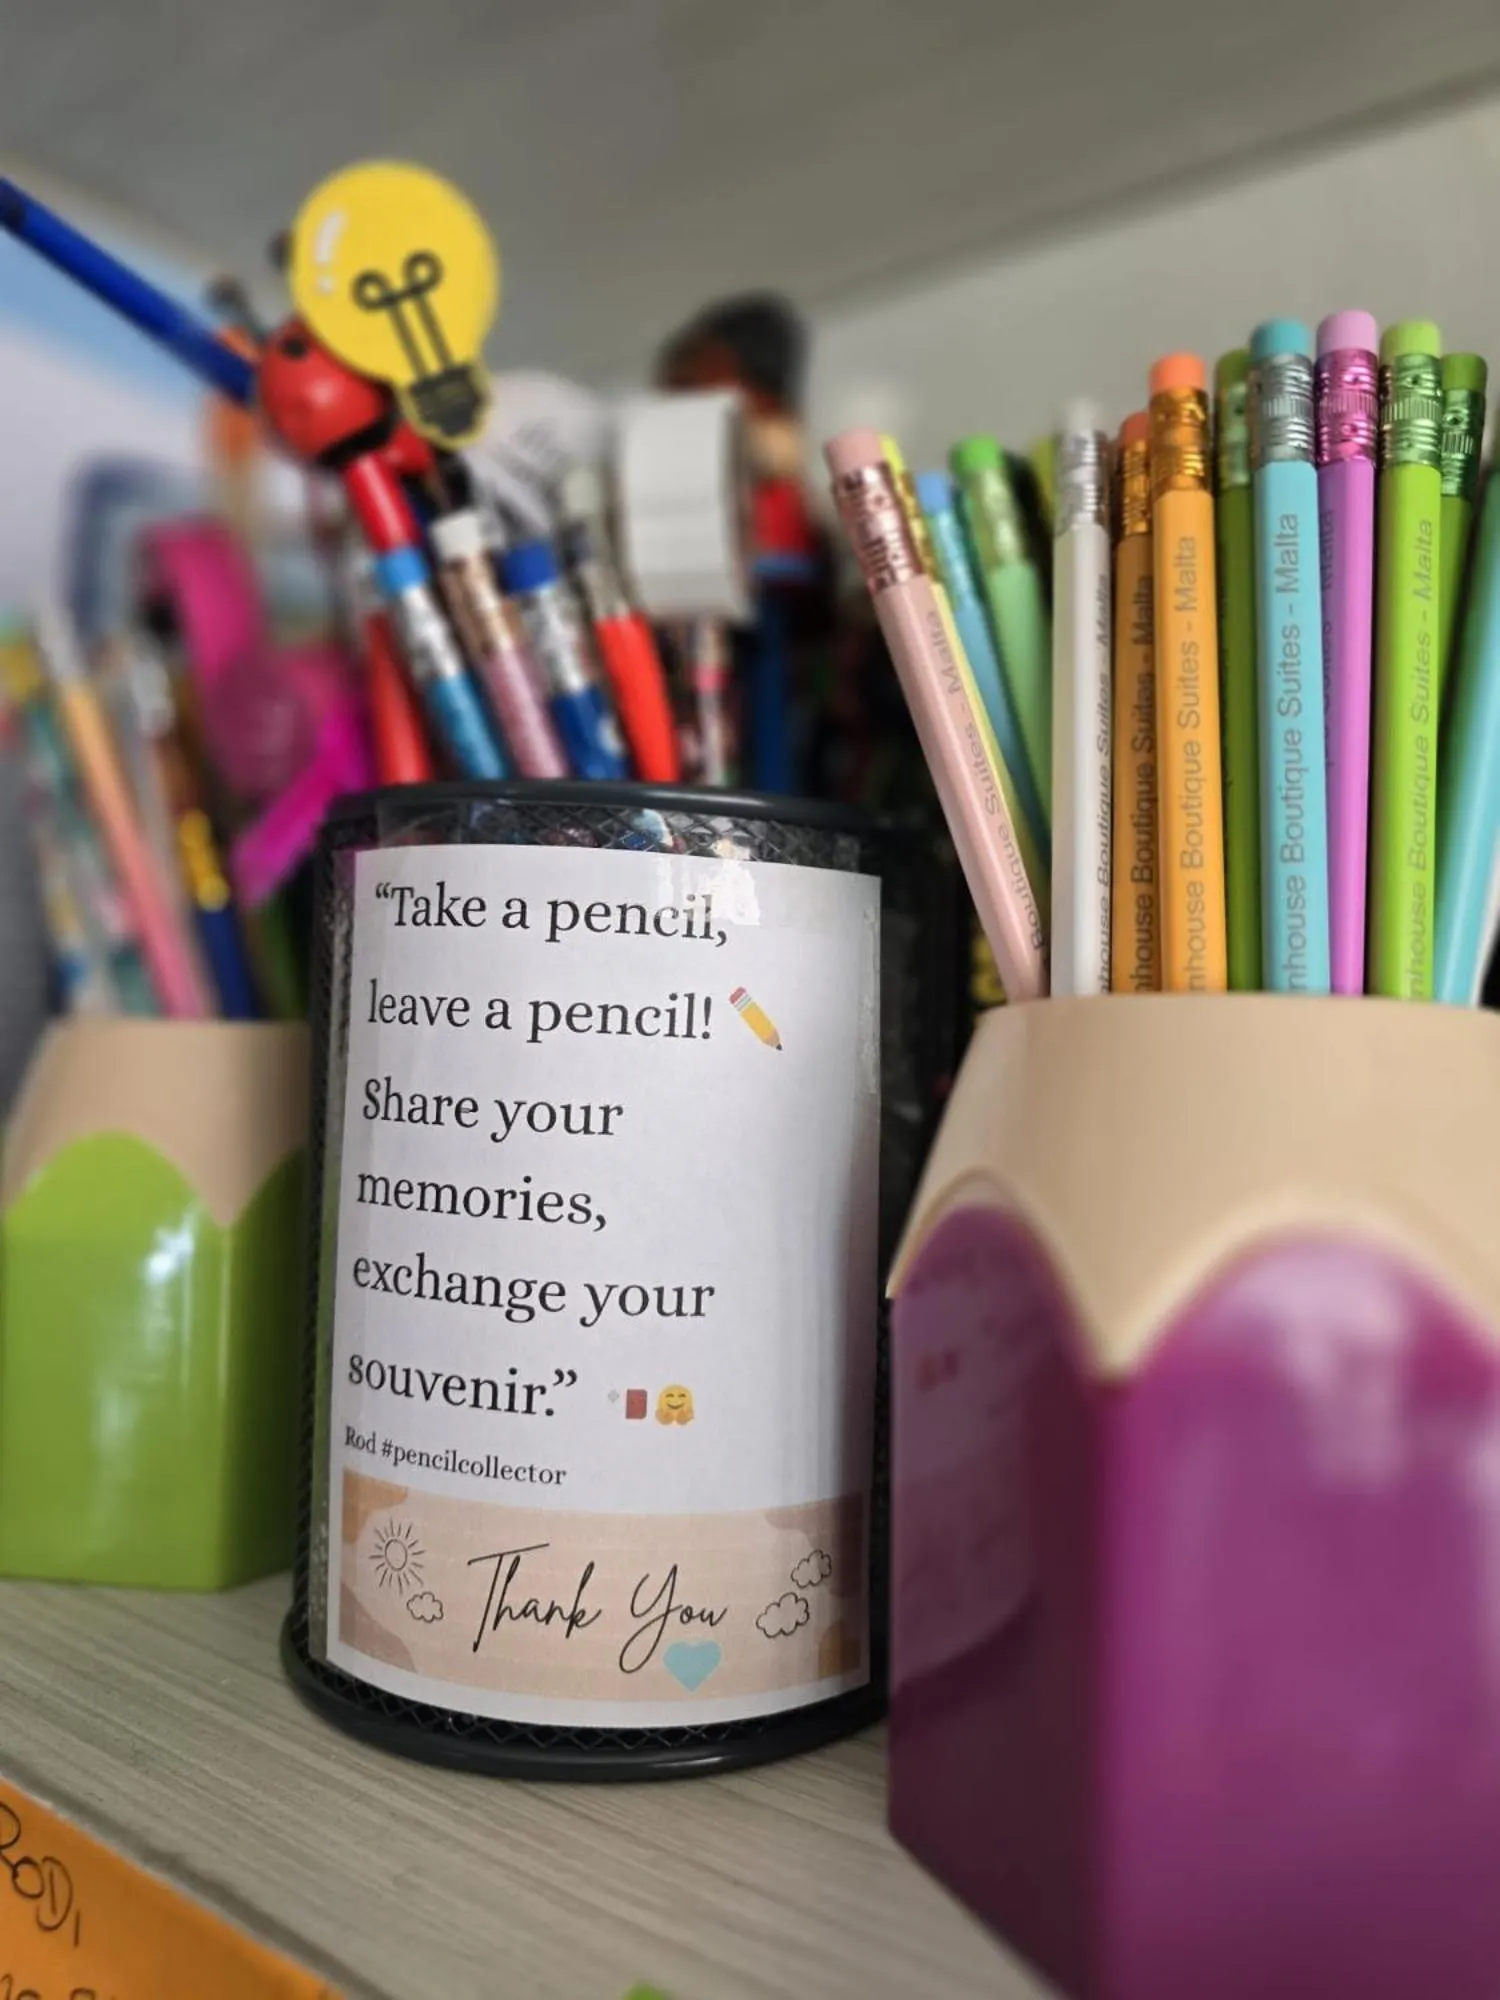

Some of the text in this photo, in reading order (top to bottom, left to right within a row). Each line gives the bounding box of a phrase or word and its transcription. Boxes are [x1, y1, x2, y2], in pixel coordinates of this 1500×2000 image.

[1174, 535, 1198, 613] Malta
[1274, 513, 1299, 594] Malta
[1412, 519, 1433, 602] Malta
[926, 609, 958, 695] Malta
[1096, 574, 1110, 648] Malta
[1131, 574, 1154, 646] Malta
[1132, 672, 1155, 753] Suites
[1177, 640, 1201, 729] Suites
[1277, 623, 1301, 719] Suites
[1409, 631, 1432, 726] Suites
[1097, 672, 1109, 757] Suites
[964, 724, 998, 816] Suites
[1178, 740, 1208, 870] Boutique
[1280, 730, 1310, 863] Boutique
[1407, 736, 1432, 872] Boutique
[1097, 765, 1110, 888] Boutique
[1130, 764, 1158, 885] Boutique
[502, 896, 530, 930] a
[545, 894, 728, 947] pencil,
[367, 978, 712, 1043] leave a pencil!
[363, 1077, 623, 1143] Share your
[357, 1172, 607, 1231] memories,
[353, 1252, 715, 1327] exchange your
[344, 1426, 567, 1486] Rod #pencilcollector
[467, 1543, 729, 1675] Thank You
